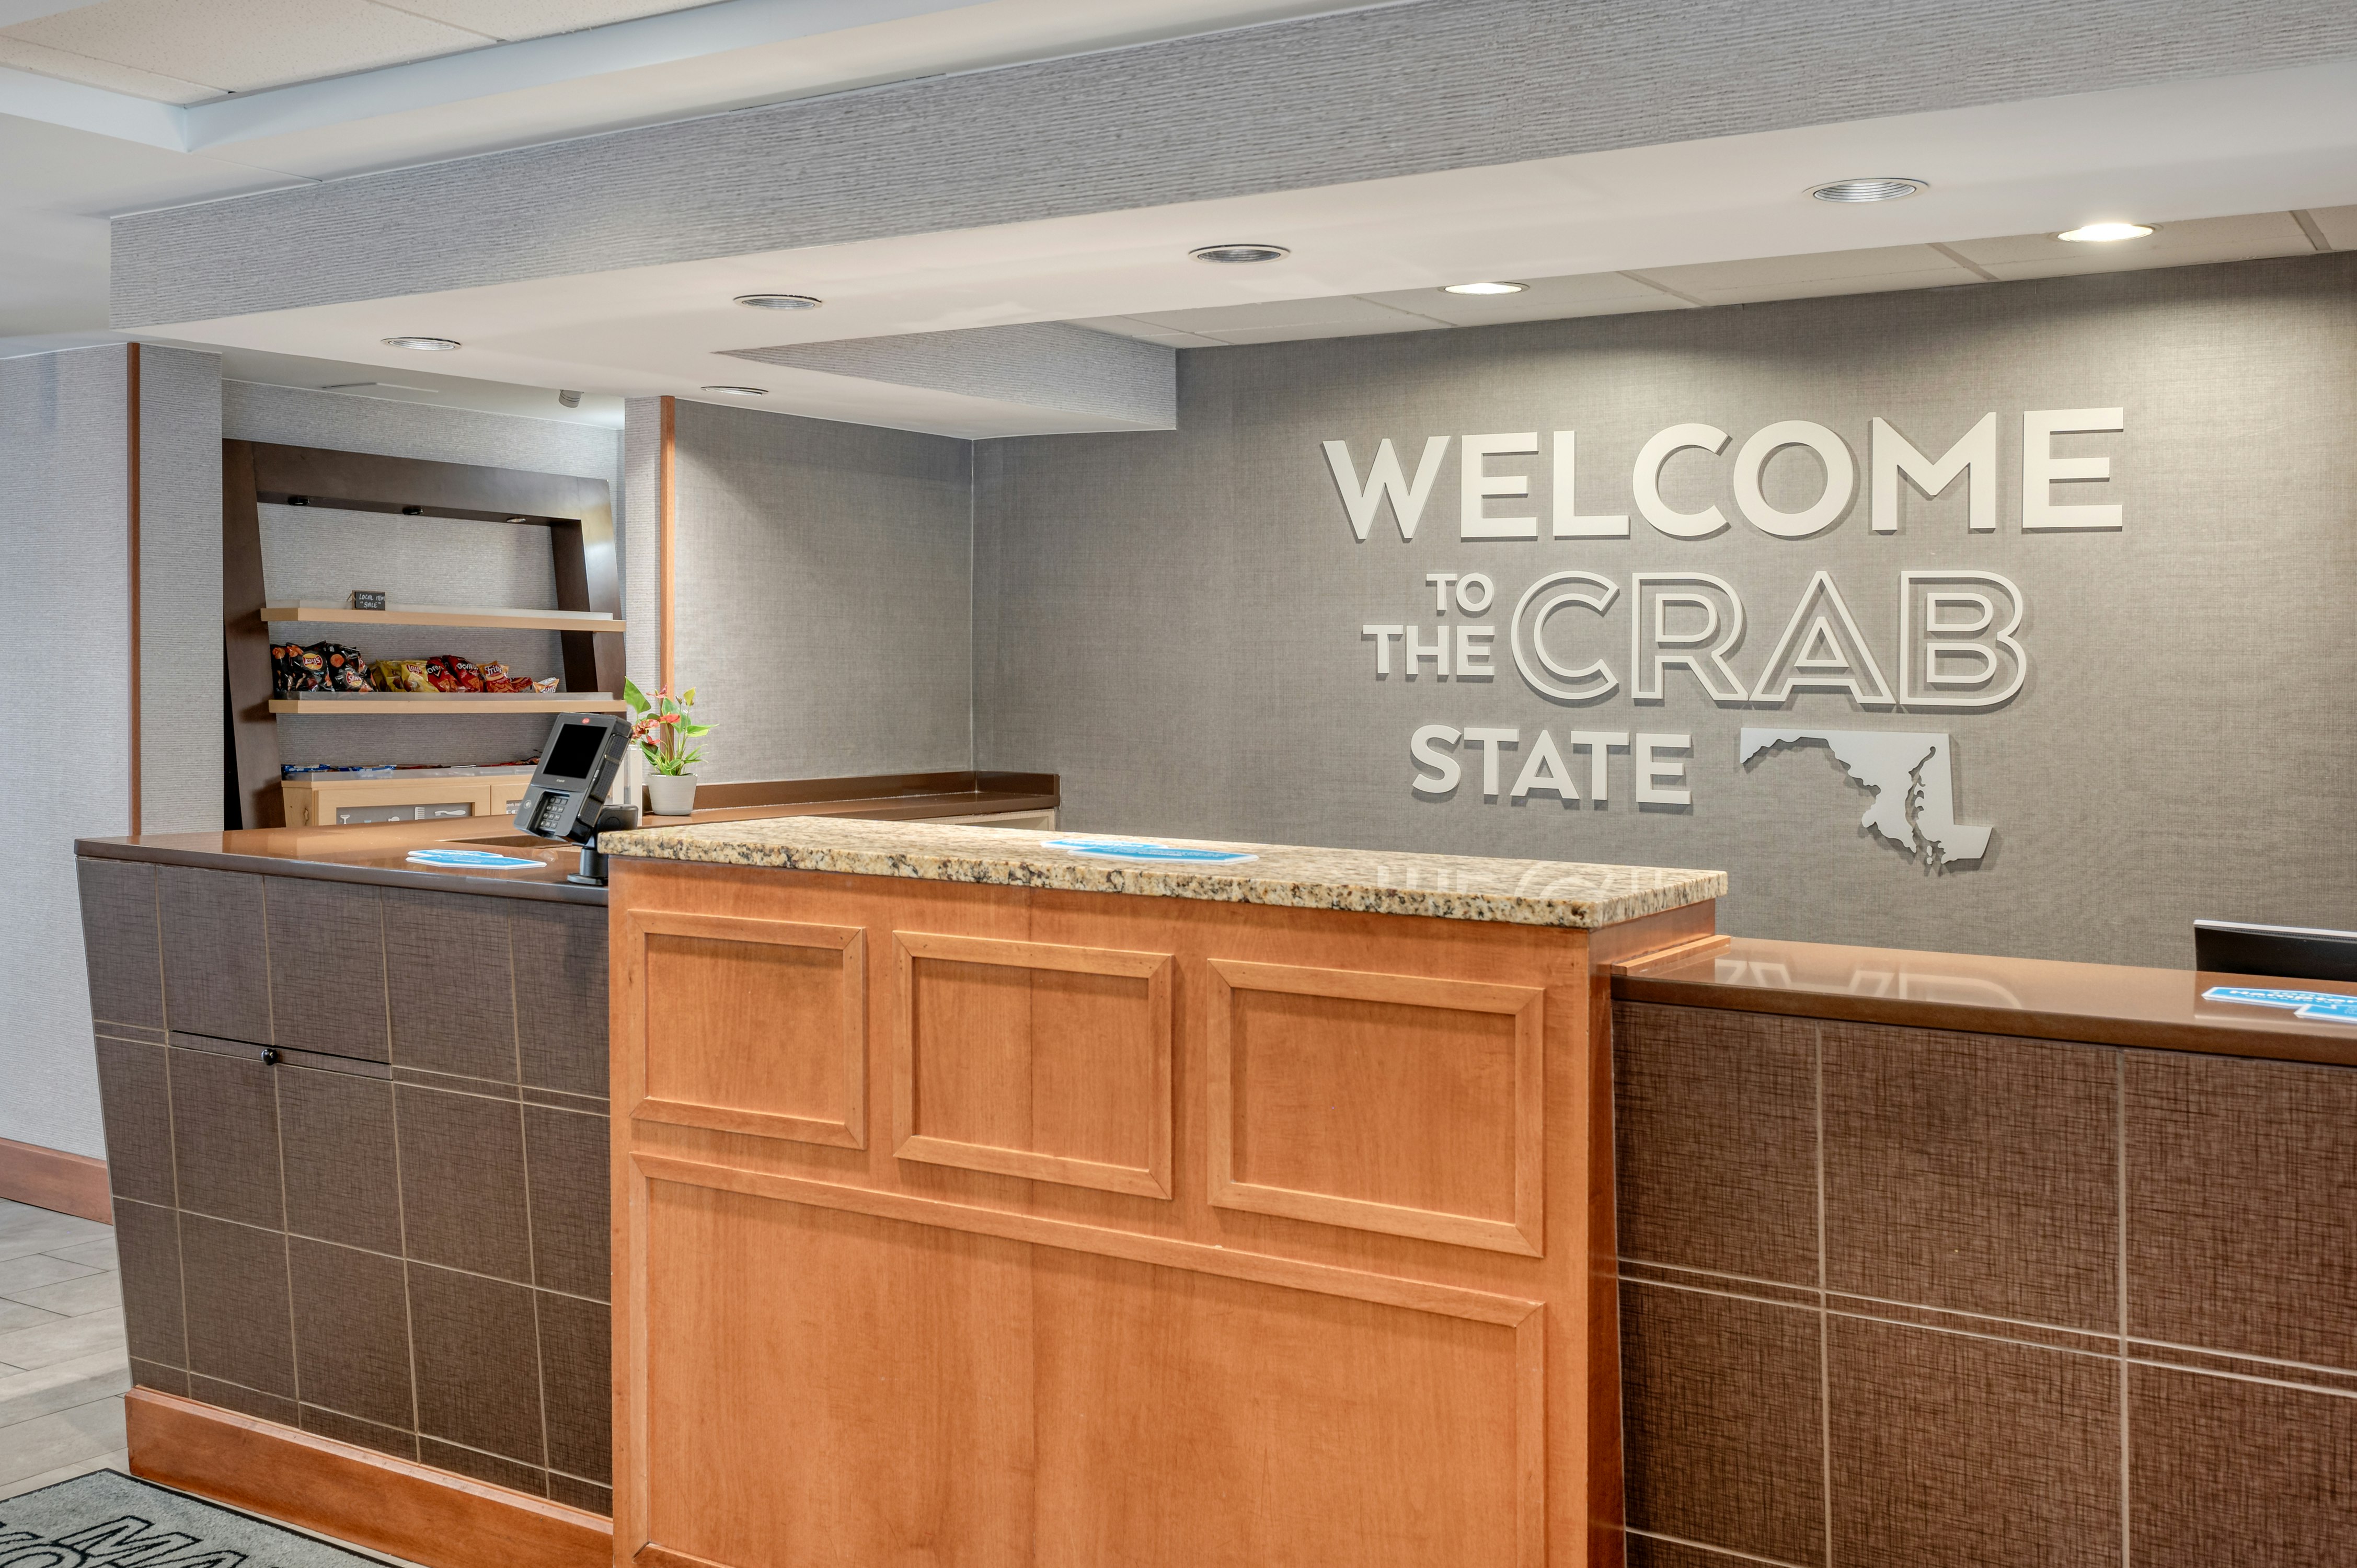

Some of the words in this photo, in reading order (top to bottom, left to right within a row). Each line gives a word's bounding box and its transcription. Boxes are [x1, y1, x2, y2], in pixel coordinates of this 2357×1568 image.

[1323, 407, 2123, 539] WELCOME
[1363, 625, 1494, 676] THE
[1511, 570, 2027, 706] CRAB
[1425, 573, 1494, 612] TO
[1411, 725, 1691, 804] STATE
